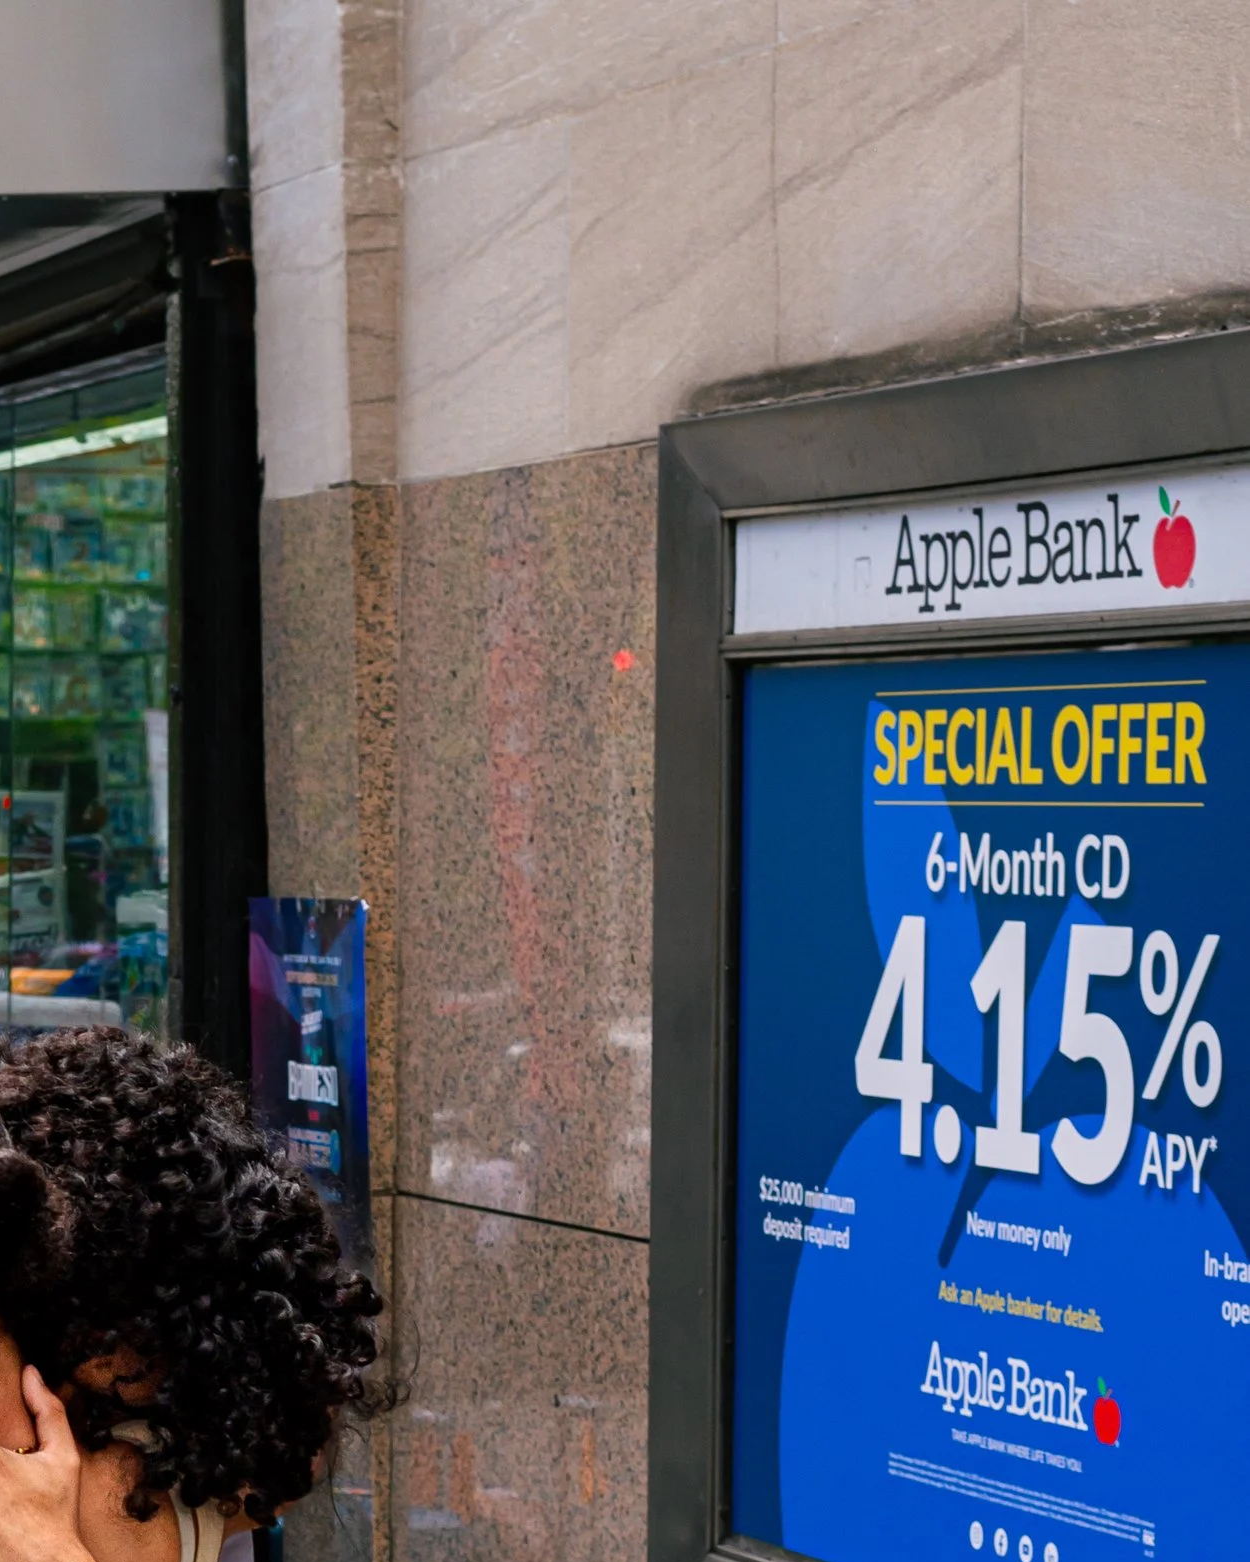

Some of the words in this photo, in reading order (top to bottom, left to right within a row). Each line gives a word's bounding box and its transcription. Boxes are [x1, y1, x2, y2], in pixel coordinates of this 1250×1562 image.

[885, 508, 1011, 612] Apple
[1017, 493, 1143, 585] Bank
[874, 706, 1044, 786] SPECIAL
[1051, 701, 1208, 785] OFFER
[925, 831, 1066, 897] 6-Month
[1075, 833, 1131, 899] CD
[854, 914, 1223, 1186] 4.15%
[759, 1174, 803, 1206] $25,000
[804, 1185, 856, 1215] minimum
[763, 1211, 803, 1242] deposit
[804, 1223, 850, 1250] required
[966, 1209, 996, 1239] New
[997, 1221, 1042, 1252] money
[1042, 1224, 1073, 1257] only
[1204, 1249, 1250, 1284] In-bra
[938, 1279, 959, 1303] Ask
[960, 1289, 974, 1306] an
[974, 1287, 1006, 1315] Apple
[1007, 1292, 1044, 1320] banker
[1045, 1300, 1062, 1324] for
[1063, 1304, 1104, 1333] details.
[920, 1340, 1005, 1418] Apple
[1006, 1356, 1089, 1431] Bank
